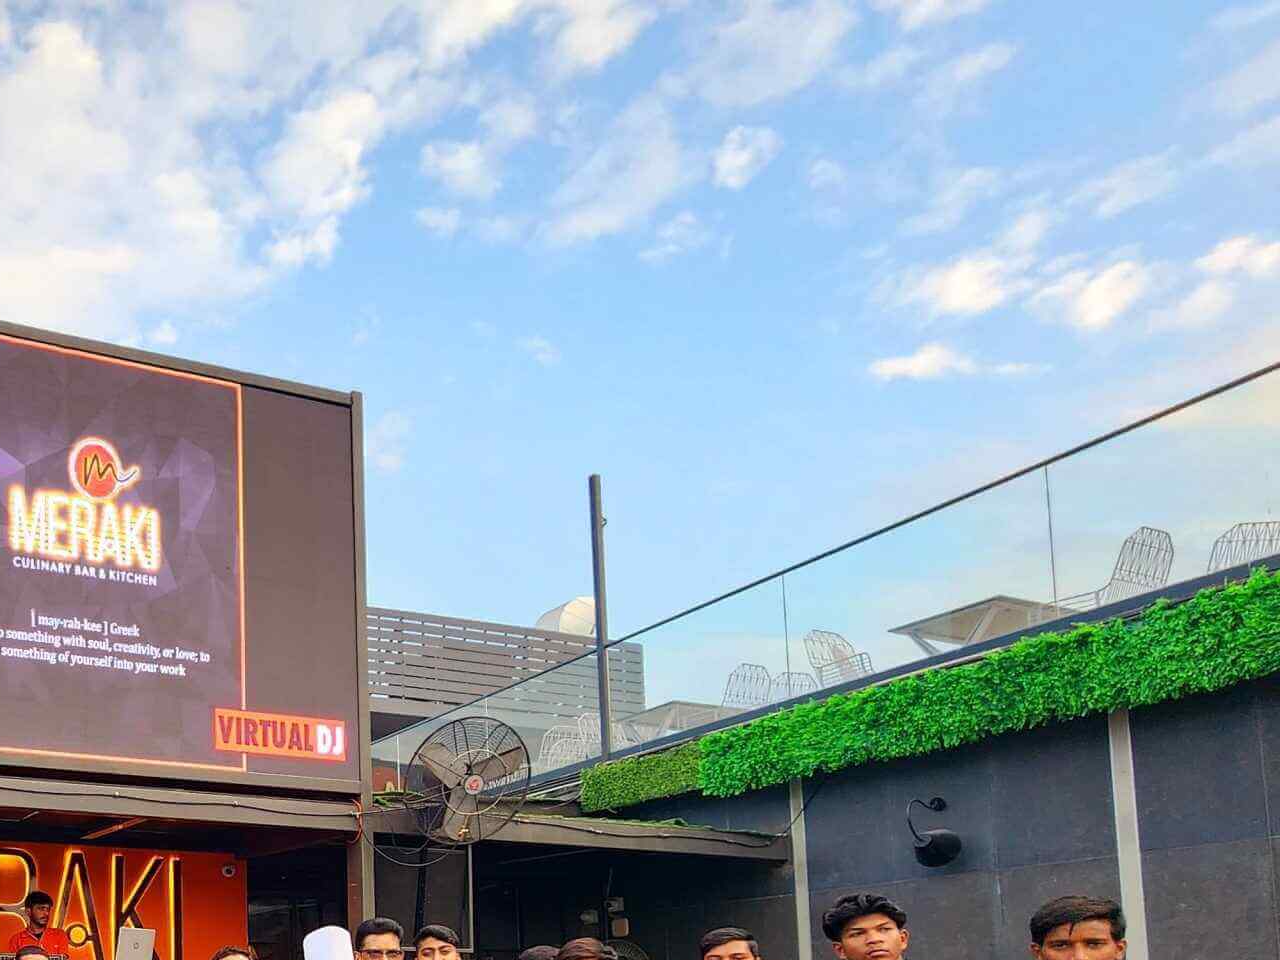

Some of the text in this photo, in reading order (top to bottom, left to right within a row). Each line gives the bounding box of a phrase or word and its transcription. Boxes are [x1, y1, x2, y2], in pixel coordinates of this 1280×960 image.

[9, 485, 161, 573] MERAKI
[12, 556, 158, 587] CULINARY BAR & KITCHEN
[109, 622, 140, 637] Greek
[6, 628, 61, 648] something
[62, 634, 86, 648] with
[87, 638, 112, 652] soul,
[112, 642, 161, 659] creativity,
[162, 648, 175, 659] or
[199, 651, 211, 663] to
[0, 646, 57, 664] something
[57, 651, 70, 663] of
[70, 654, 113, 668] yourself
[113, 656, 134, 671] into
[134, 661, 158, 674] your
[159, 663, 187, 677] work
